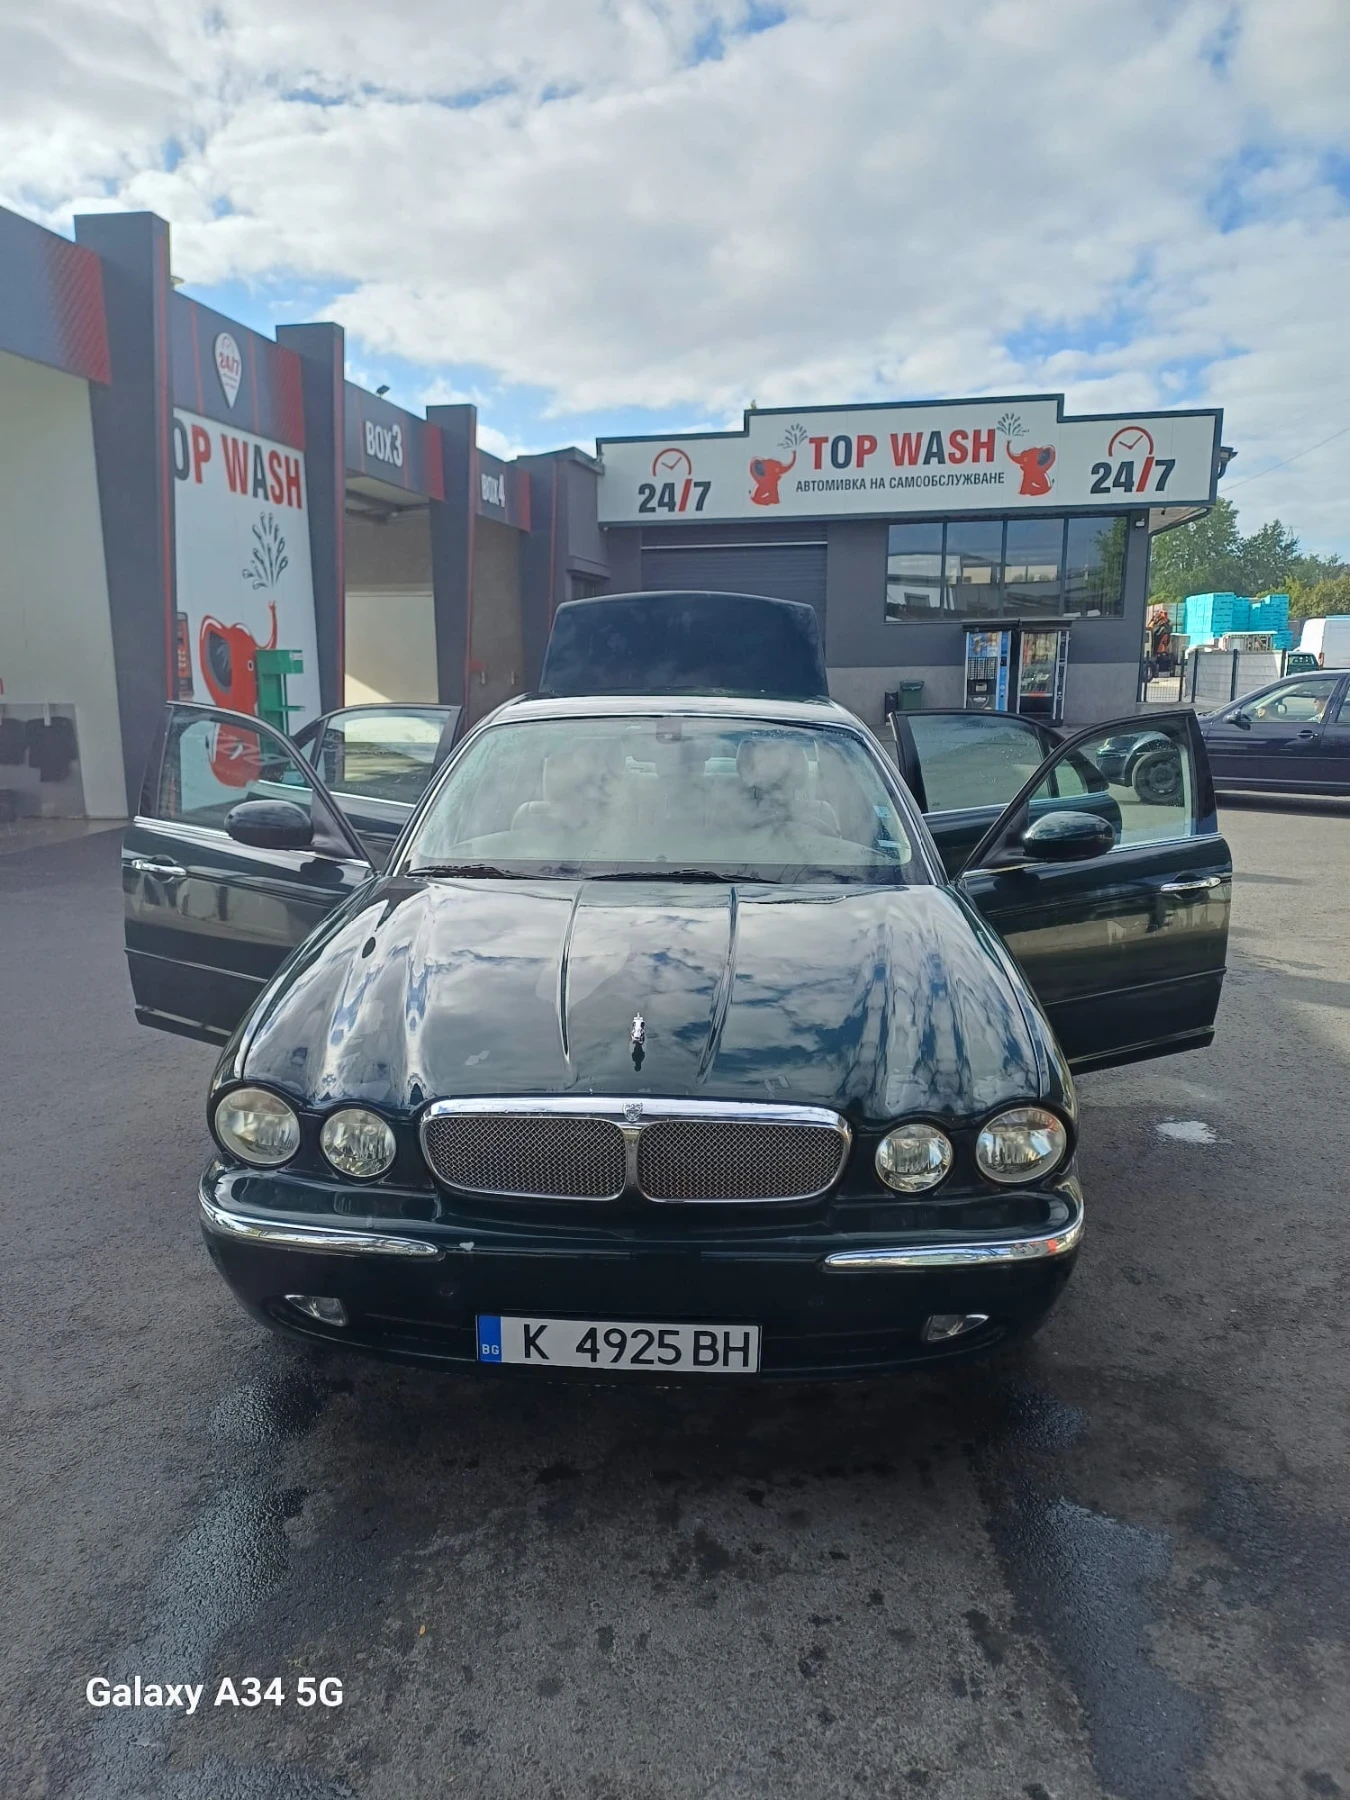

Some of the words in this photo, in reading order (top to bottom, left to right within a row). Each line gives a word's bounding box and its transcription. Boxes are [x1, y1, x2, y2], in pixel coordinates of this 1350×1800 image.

[172, 417, 212, 484] OP
[221, 433, 303, 509] WASH
[808, 434, 878, 470] TOP
[890, 428, 996, 467] WASH
[796, 477, 867, 492] АВТОМИВКА
[870, 476, 886, 490] НА
[889, 472, 1005, 489] САМООБСЛУЖВАНЕ
[1090, 456, 1176, 494] 24/7
[638, 478, 712, 514] 24/7
[482, 1343, 500, 1355] BG
[523, 1323, 550, 1360] K
[575, 1326, 682, 1366] 4925
[692, 1331, 750, 1368] BH
